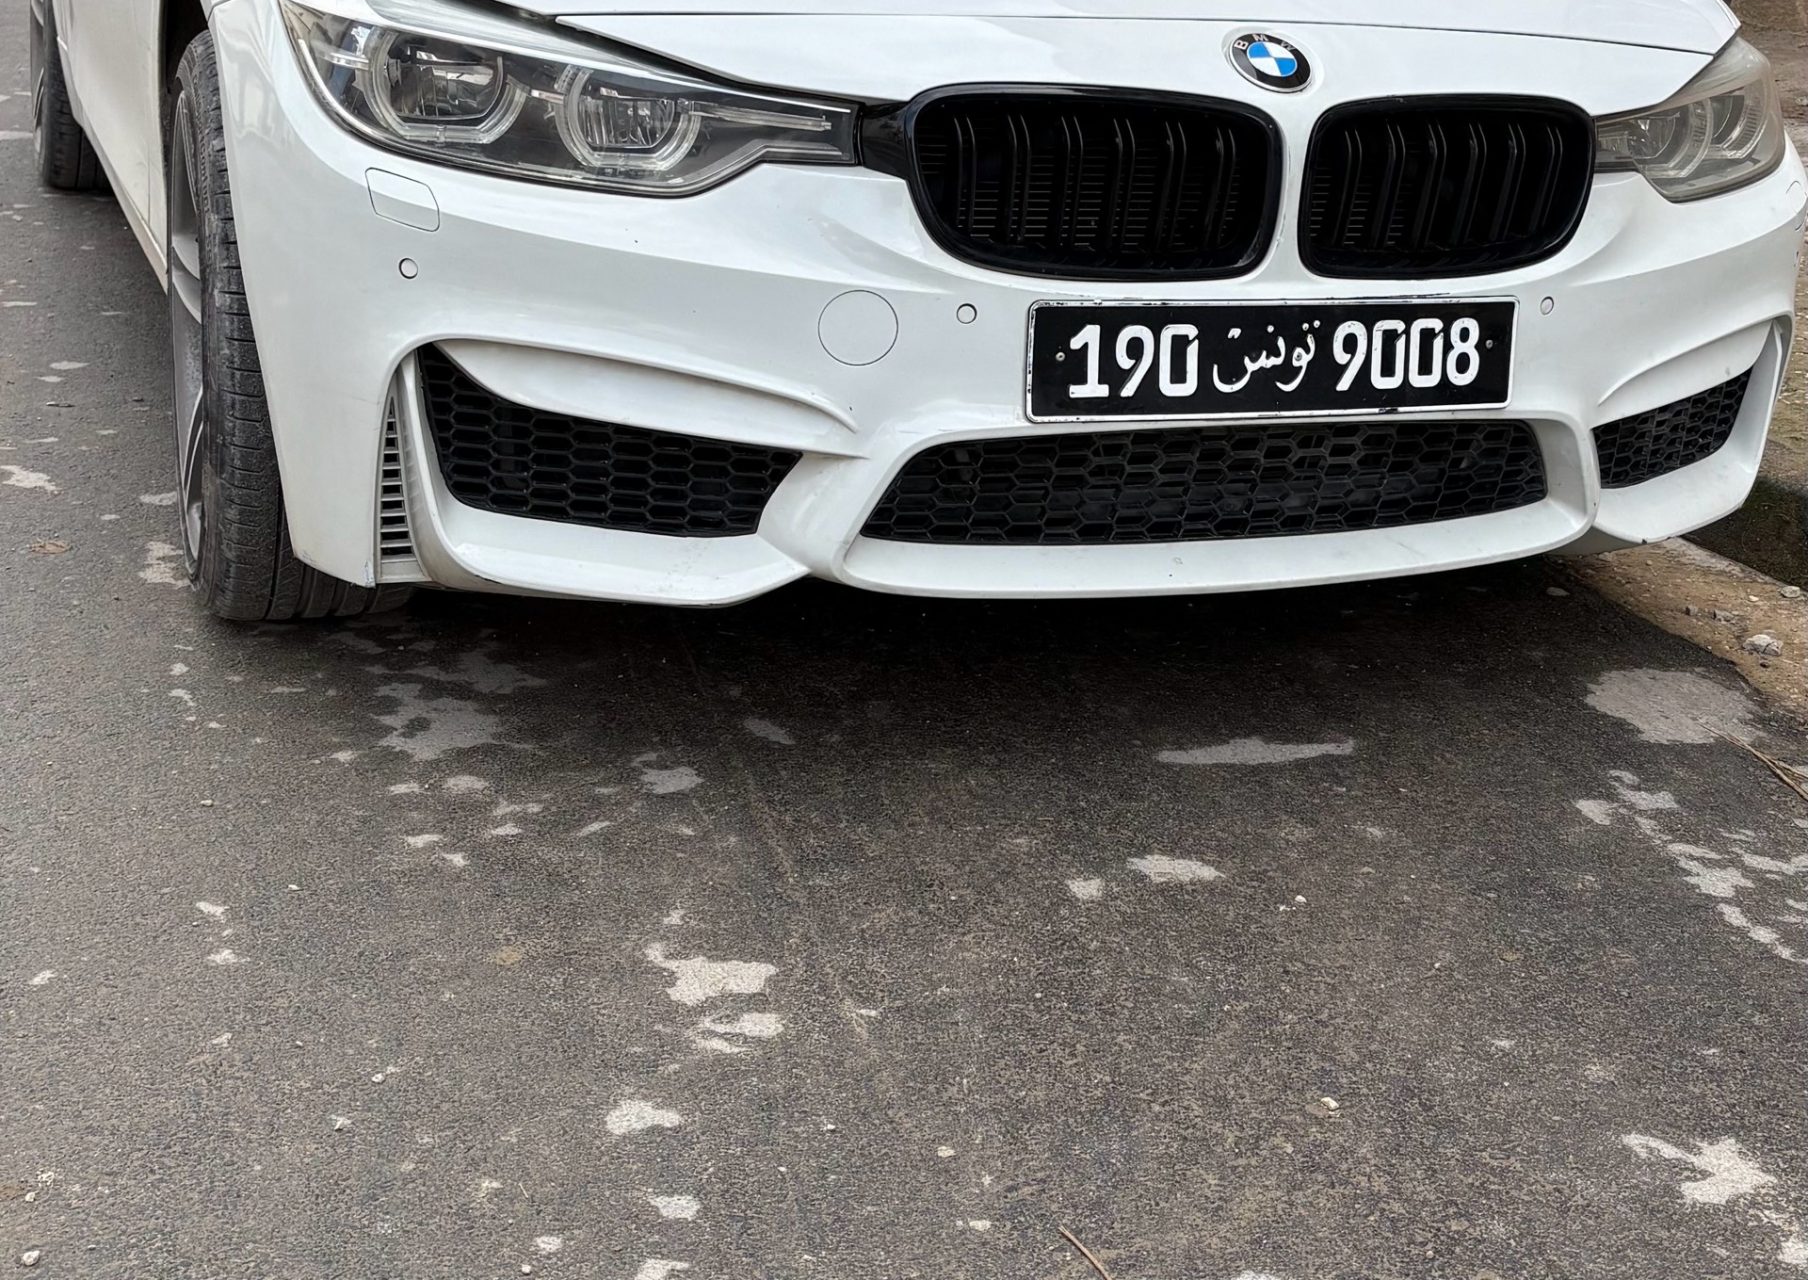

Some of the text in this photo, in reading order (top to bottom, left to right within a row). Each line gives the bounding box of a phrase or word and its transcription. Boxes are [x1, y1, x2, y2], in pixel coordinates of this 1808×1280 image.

[1233, 33, 1296, 51] BMW
[1068, 317, 1480, 398] 190 تونس 9008
